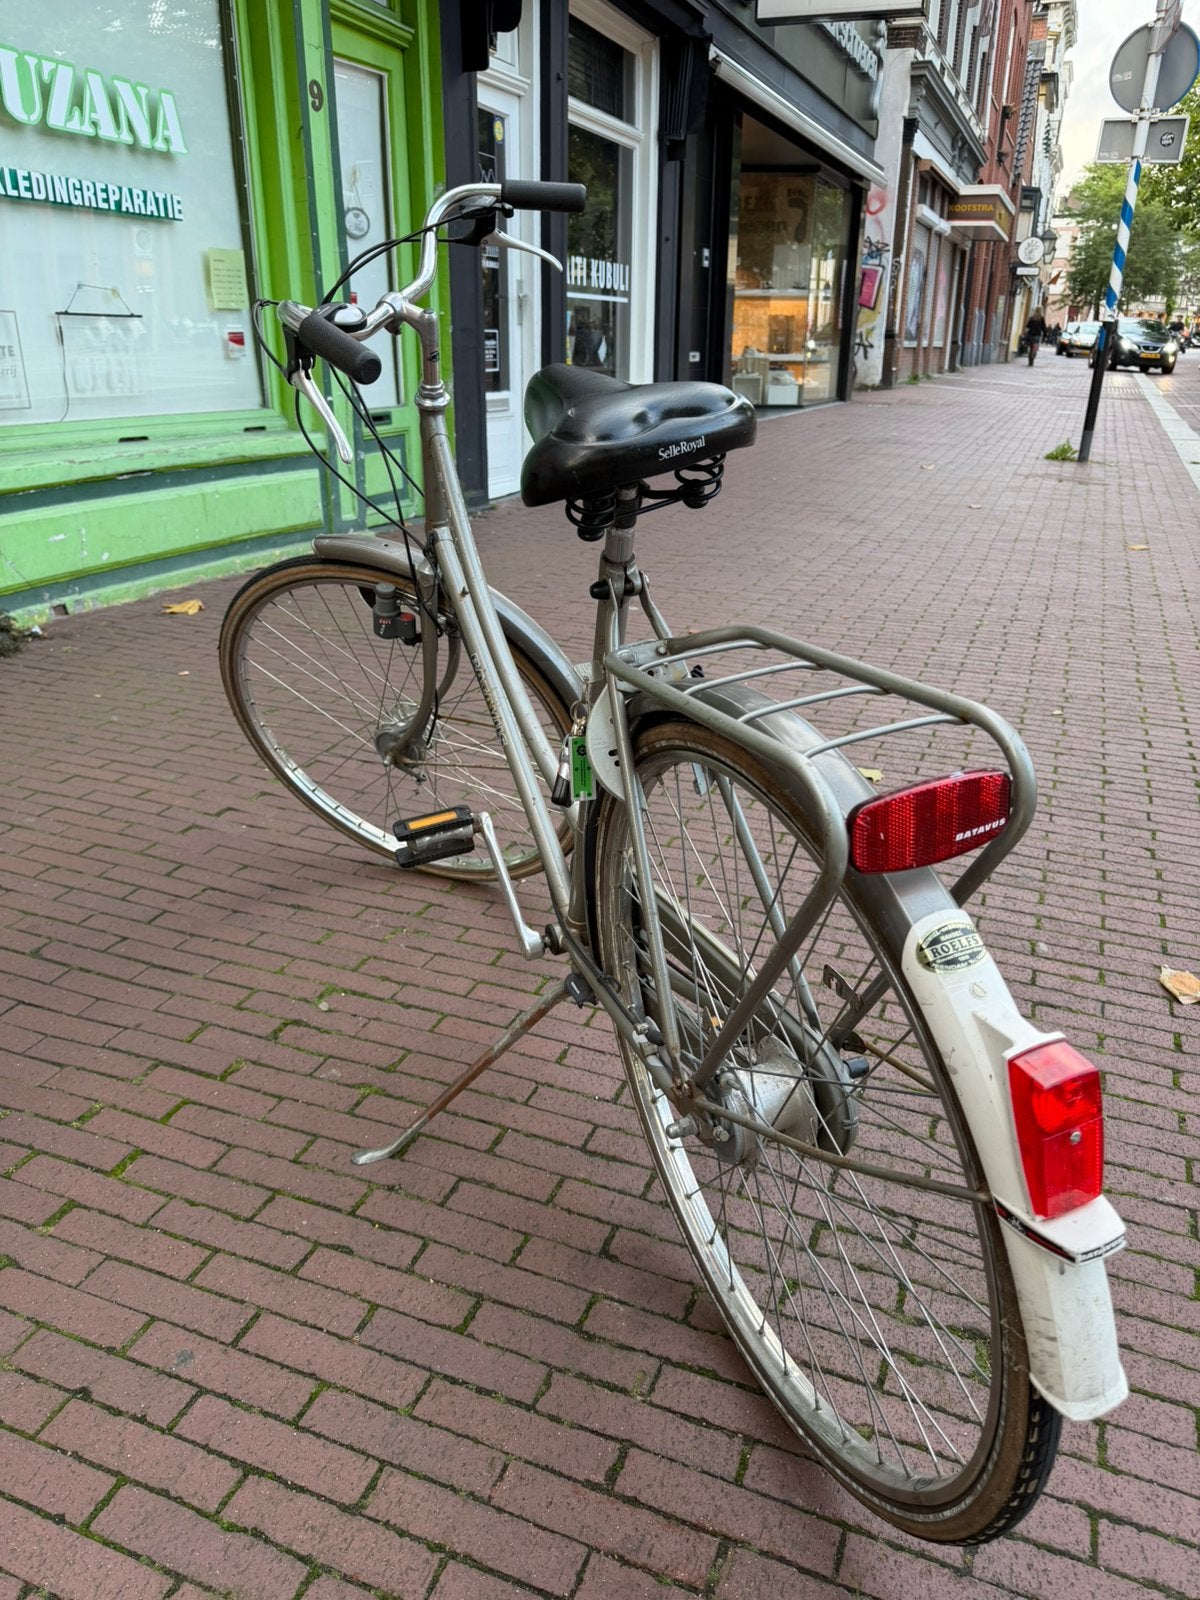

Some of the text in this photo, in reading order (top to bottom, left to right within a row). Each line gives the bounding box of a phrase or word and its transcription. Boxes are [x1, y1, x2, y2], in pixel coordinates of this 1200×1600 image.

[309, 79, 324, 112] 9
[949, 204, 993, 212] KOOTSTRA
[591, 258, 629, 291] KUBULI
[955, 817, 1006, 842] BATAVUS
[930, 935, 979, 958] ROELFS
